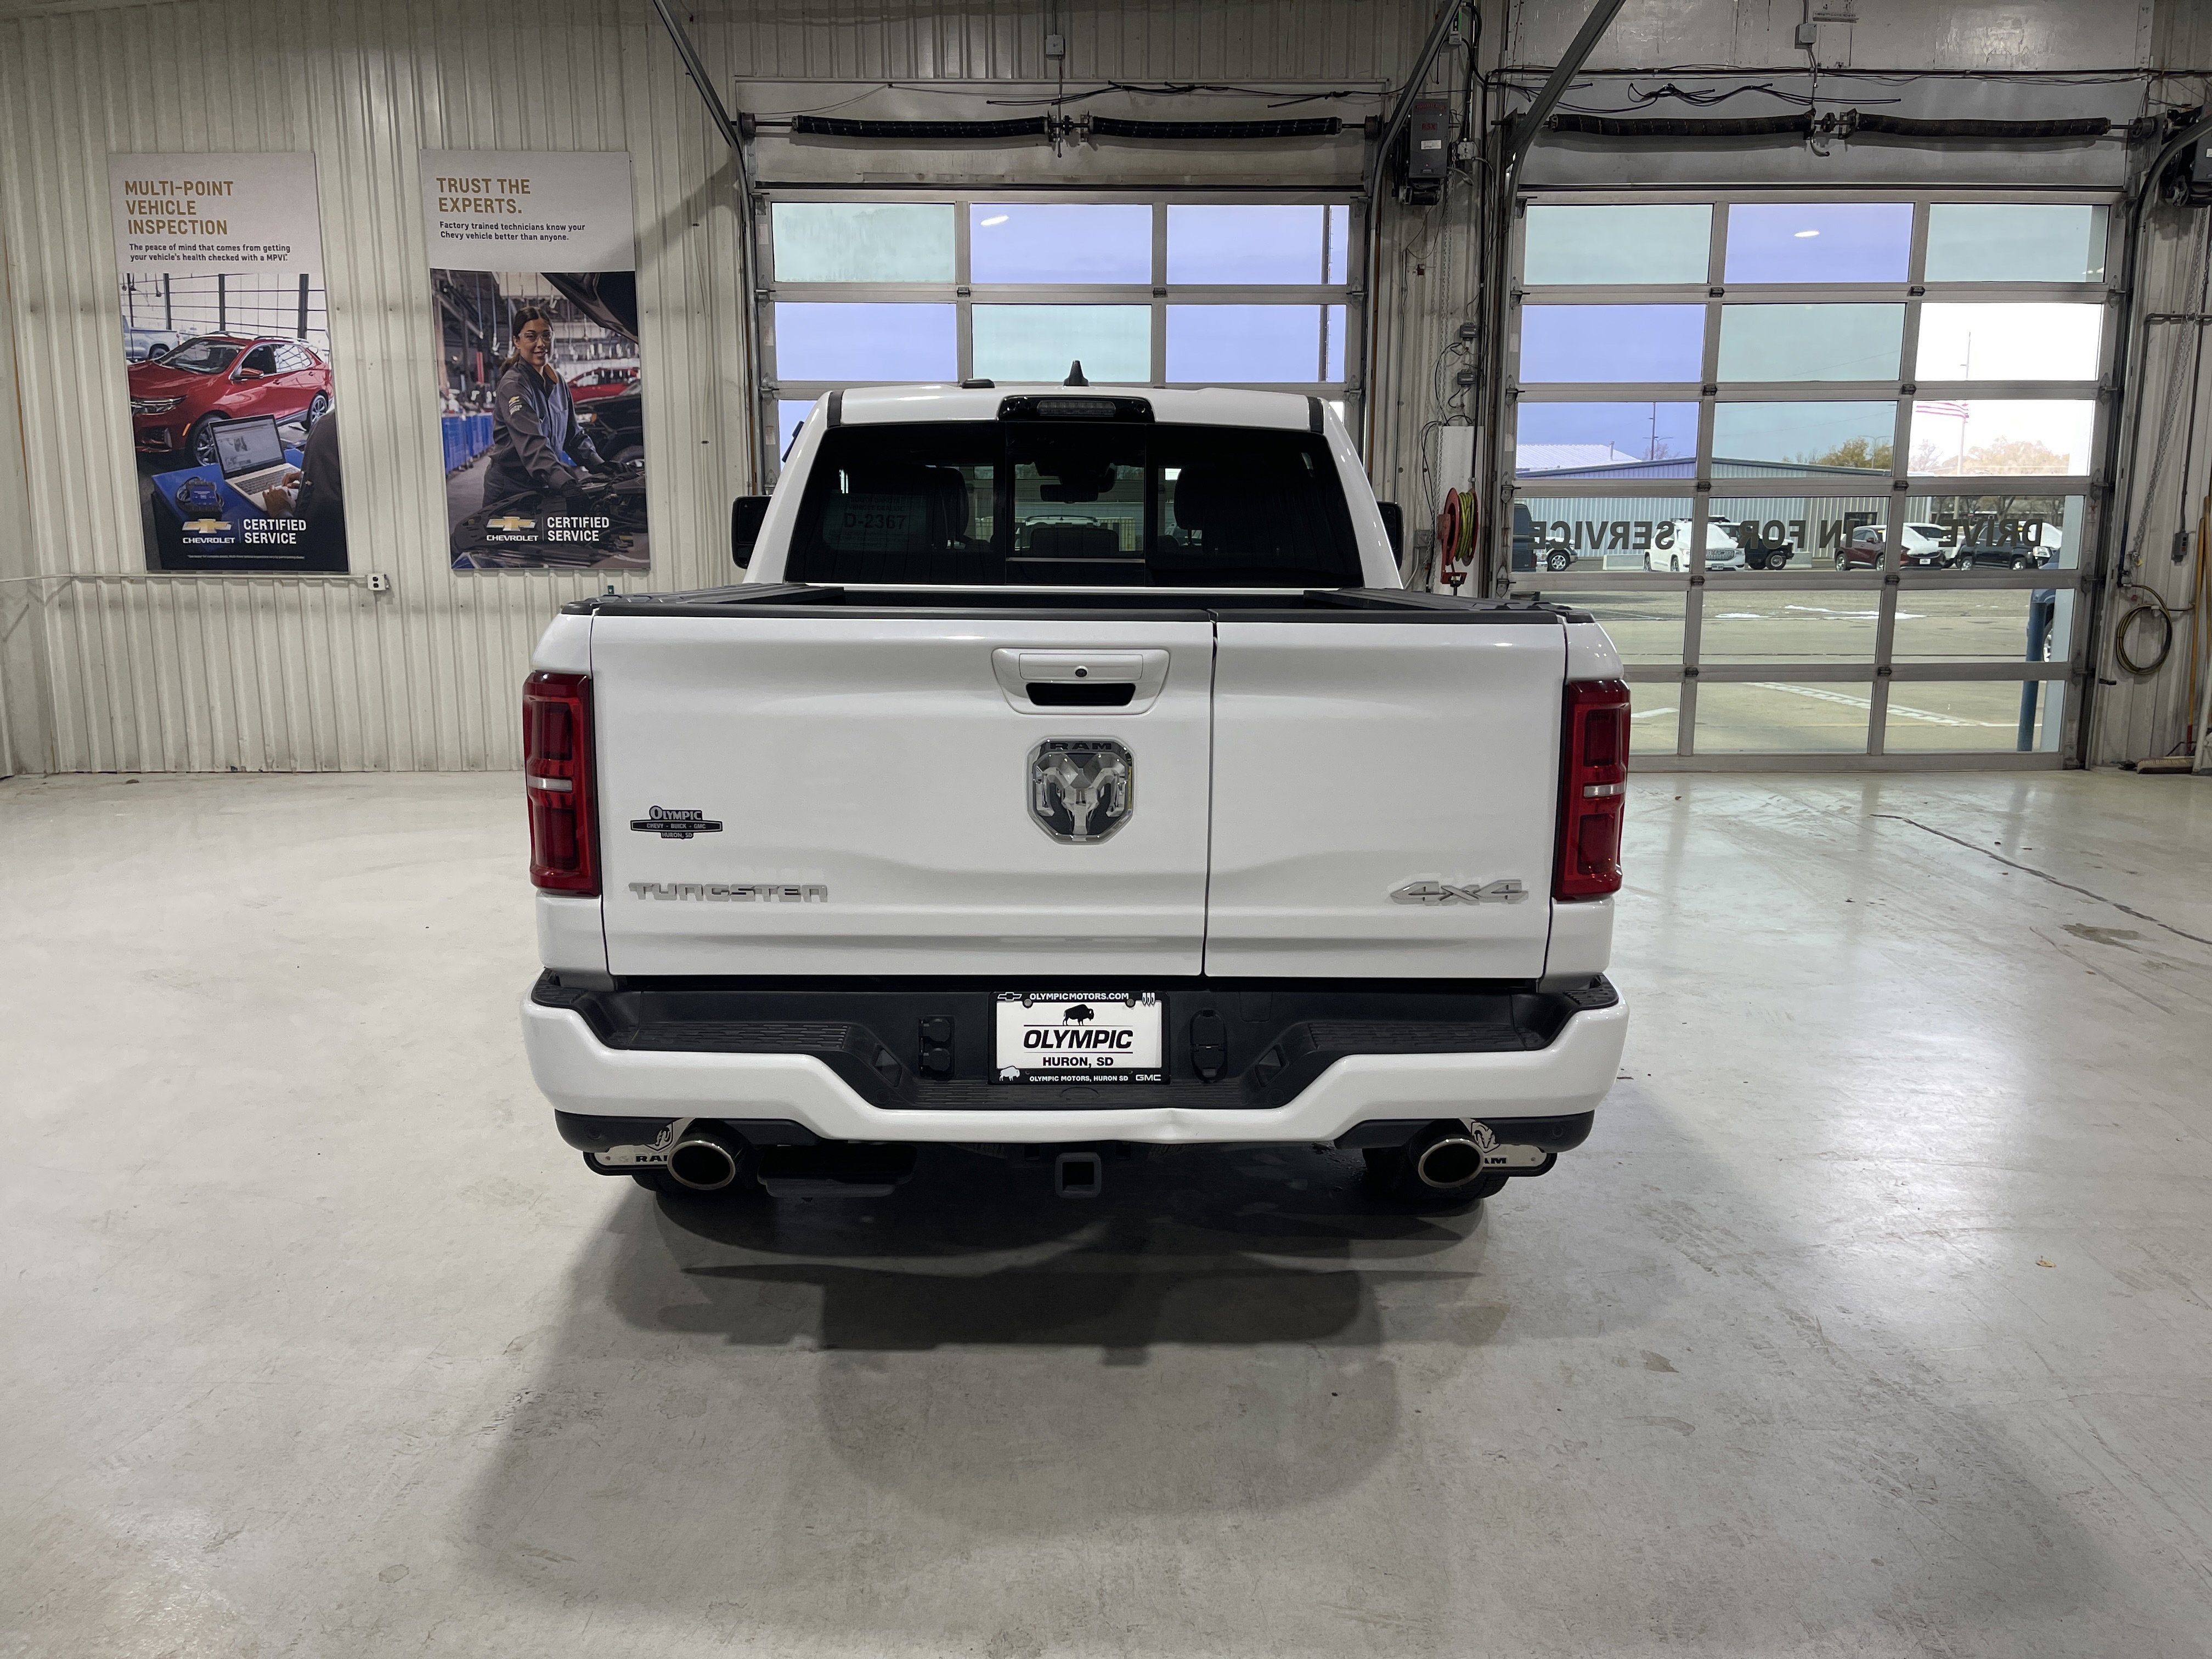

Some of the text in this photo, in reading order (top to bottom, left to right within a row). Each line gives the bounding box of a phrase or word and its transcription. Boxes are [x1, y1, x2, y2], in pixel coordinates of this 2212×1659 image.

[125, 180, 234, 196] MULTI-POINT
[436, 178, 531, 194] TRUST THE
[126, 200, 196, 215] VEHICLE
[438, 197, 522, 213] EXPERTS.
[128, 219, 228, 235] INSPECTION
[439, 221, 469, 230] Factory
[441, 231, 464, 240] Chevy
[263, 245, 291, 253] getting
[243, 518, 307, 531] CERTIFIED
[546, 517, 610, 528] CERTIFIED
[844, 513, 906, 529] D-2367
[244, 532, 297, 544] SERVICE
[547, 530, 600, 541] SERVICE
[650, 806, 702, 820] OLYMPIC
[629, 882, 828, 902] TUNGSTEN
[1023, 1030, 1133, 1049] OLYMPIC
[1042, 1057, 1114, 1068] HURON, SD
